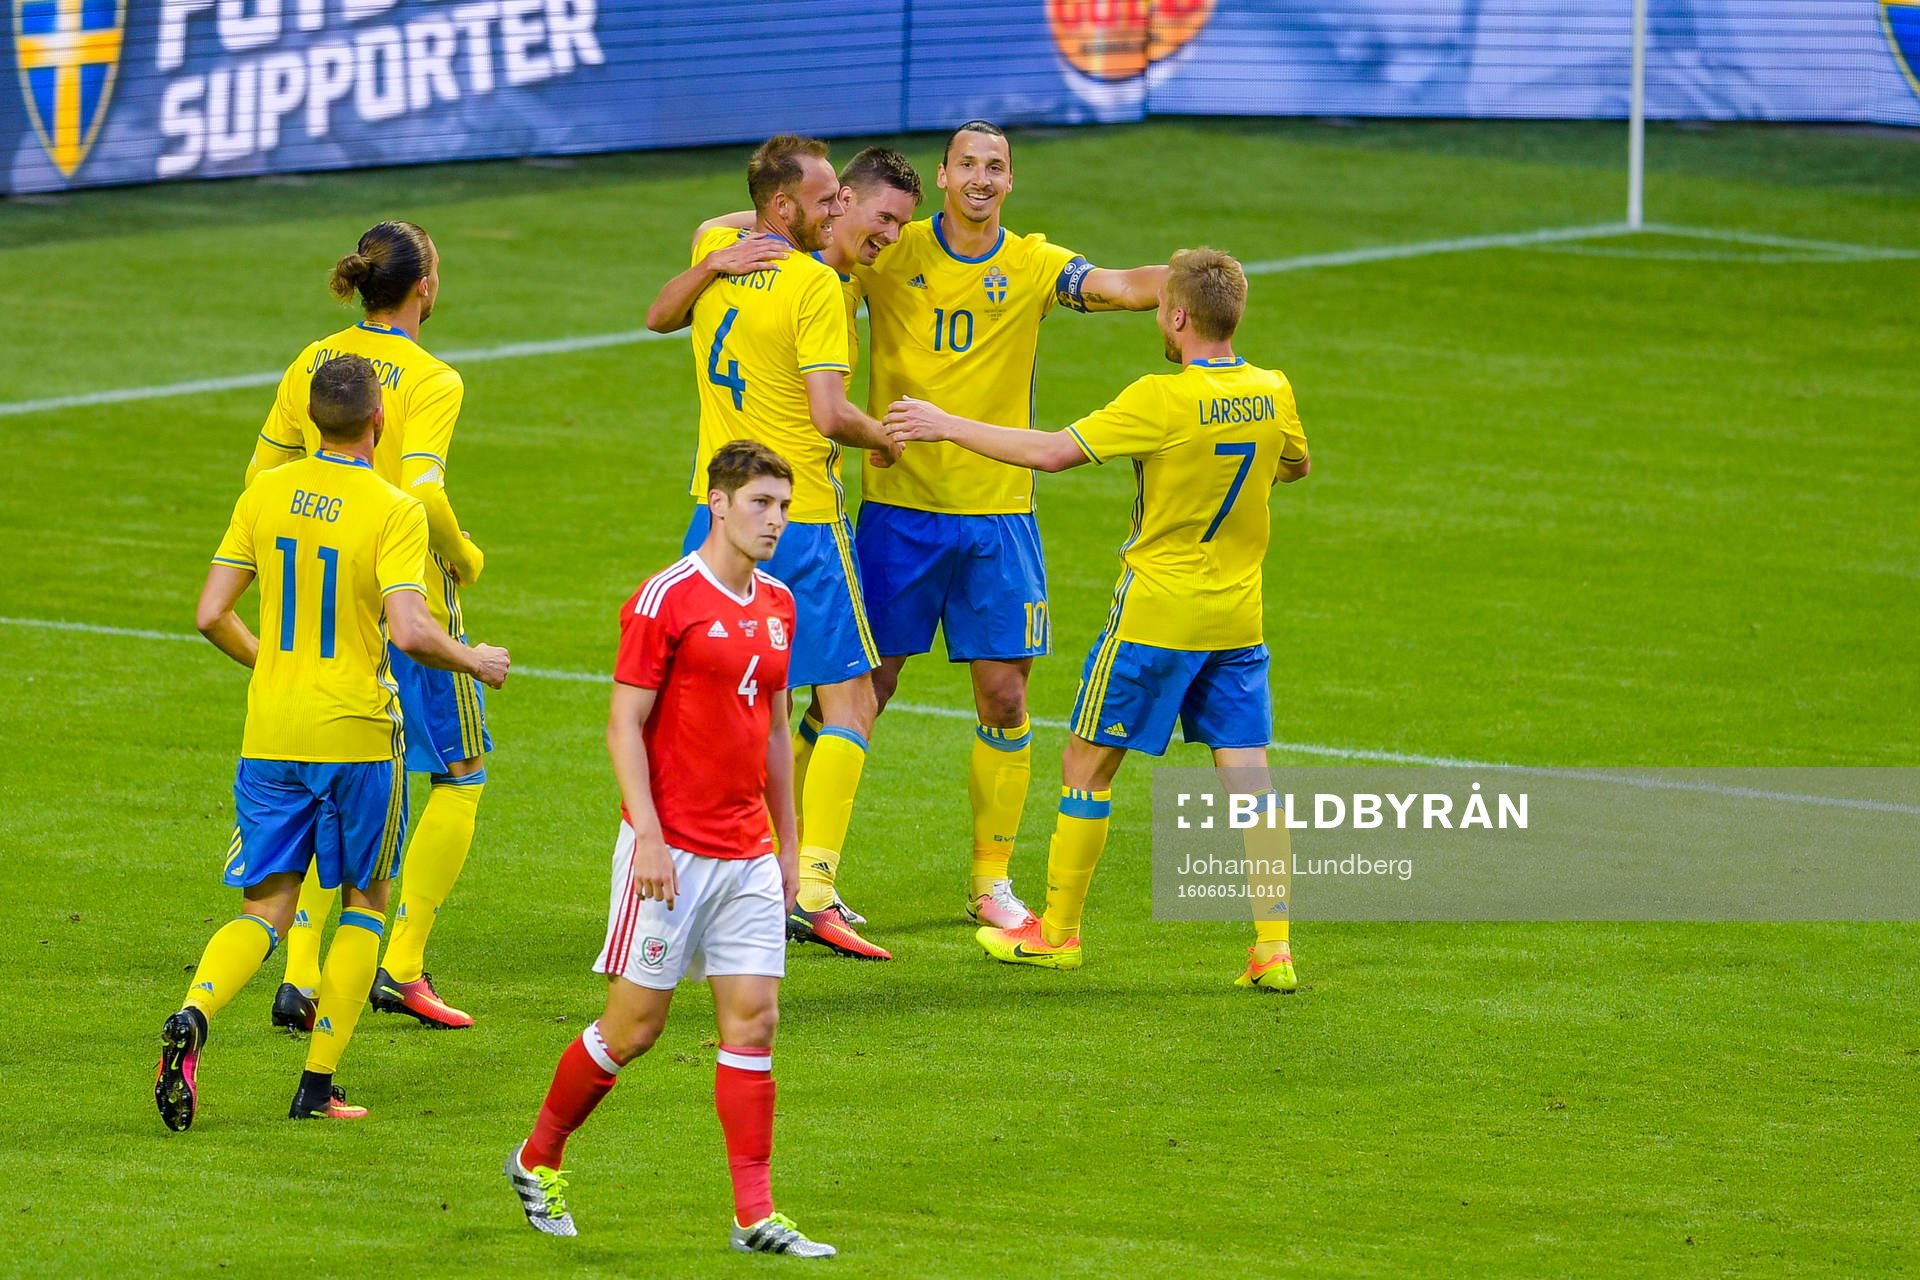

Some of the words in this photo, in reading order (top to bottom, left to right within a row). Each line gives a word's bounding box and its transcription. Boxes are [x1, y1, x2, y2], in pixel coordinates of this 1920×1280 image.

[157, 0, 605, 178] SUPPORTER
[934, 308, 974, 352] 10
[707, 307, 746, 412] 4
[1198, 395, 1275, 425] LARSSON
[290, 489, 343, 523] BERG
[1200, 442, 1257, 543] 7
[275, 536, 339, 659] 11
[1024, 601, 1046, 649] 10
[737, 654, 760, 706] 4
